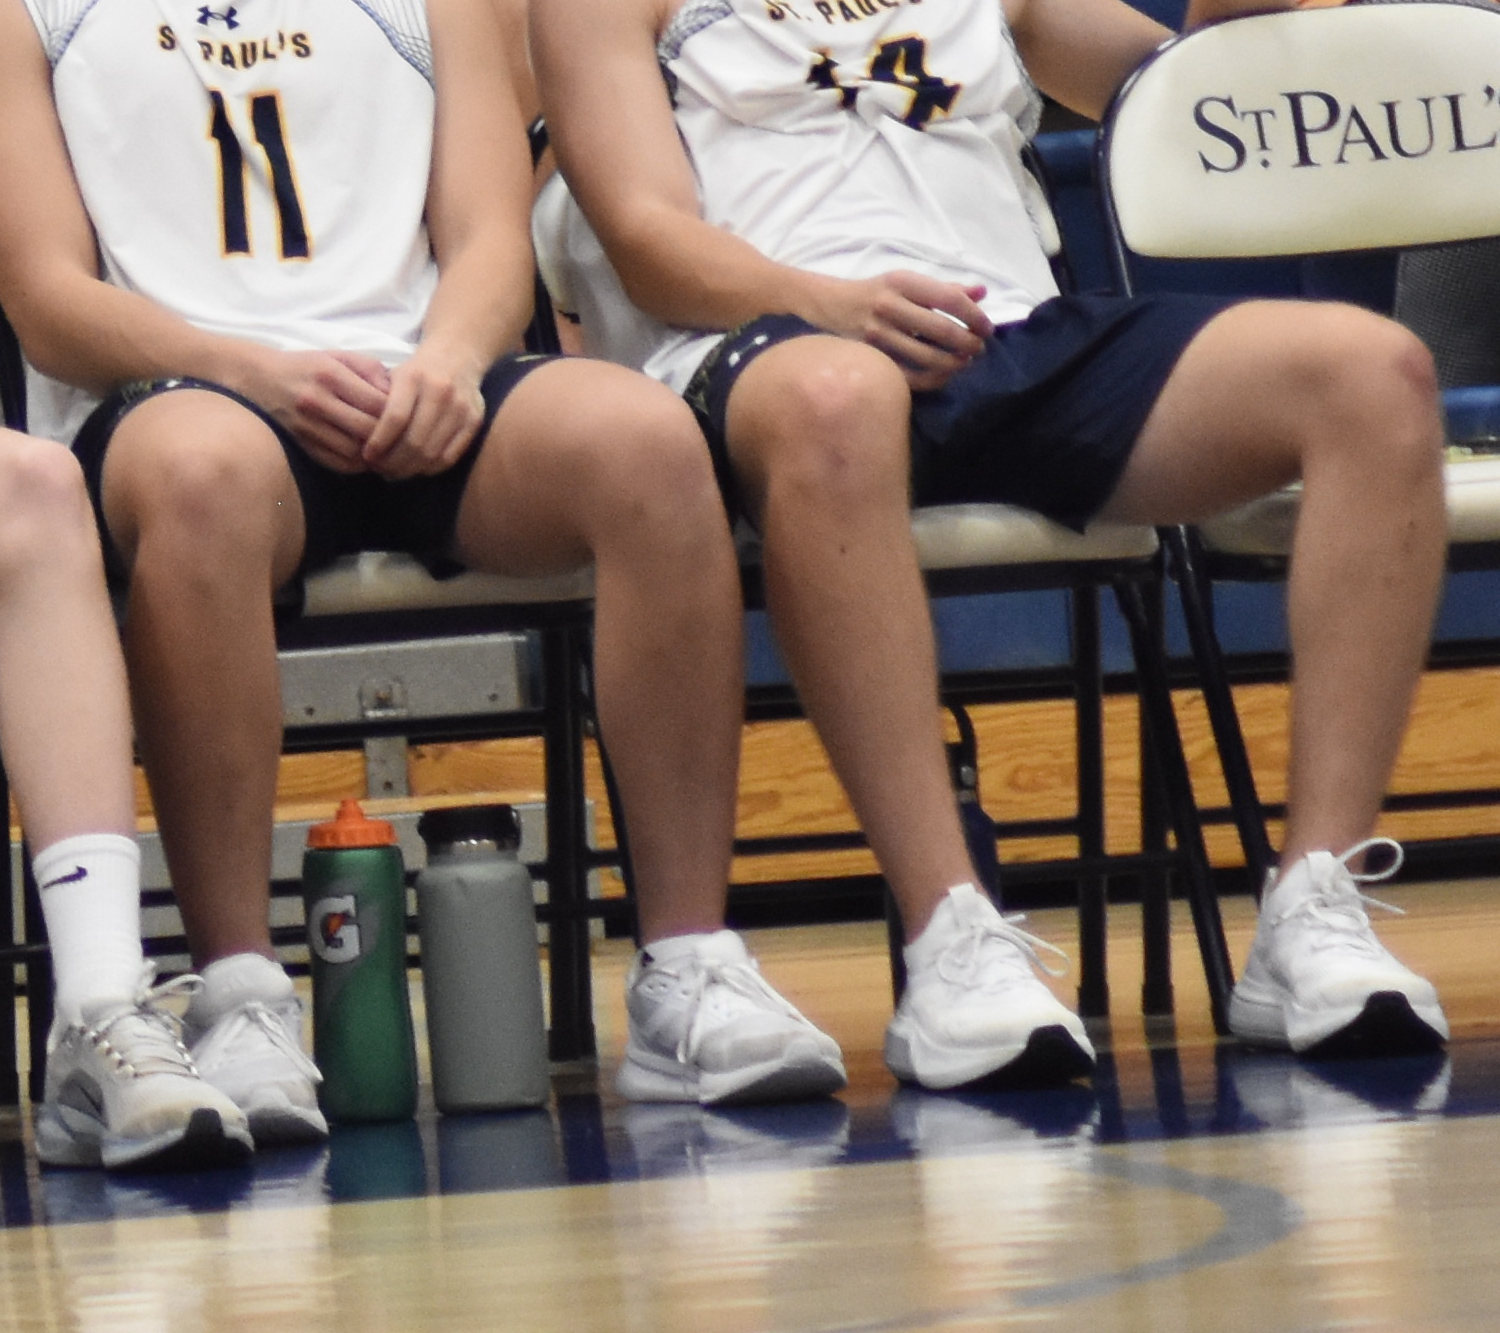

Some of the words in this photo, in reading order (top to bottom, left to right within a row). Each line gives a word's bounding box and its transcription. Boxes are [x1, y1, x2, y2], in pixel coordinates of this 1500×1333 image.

[196, 30, 312, 70] PAUL'S
[1279, 83, 1500, 169] PAUL'
[206, 86, 314, 264] 11
[310, 893, 362, 965] G
